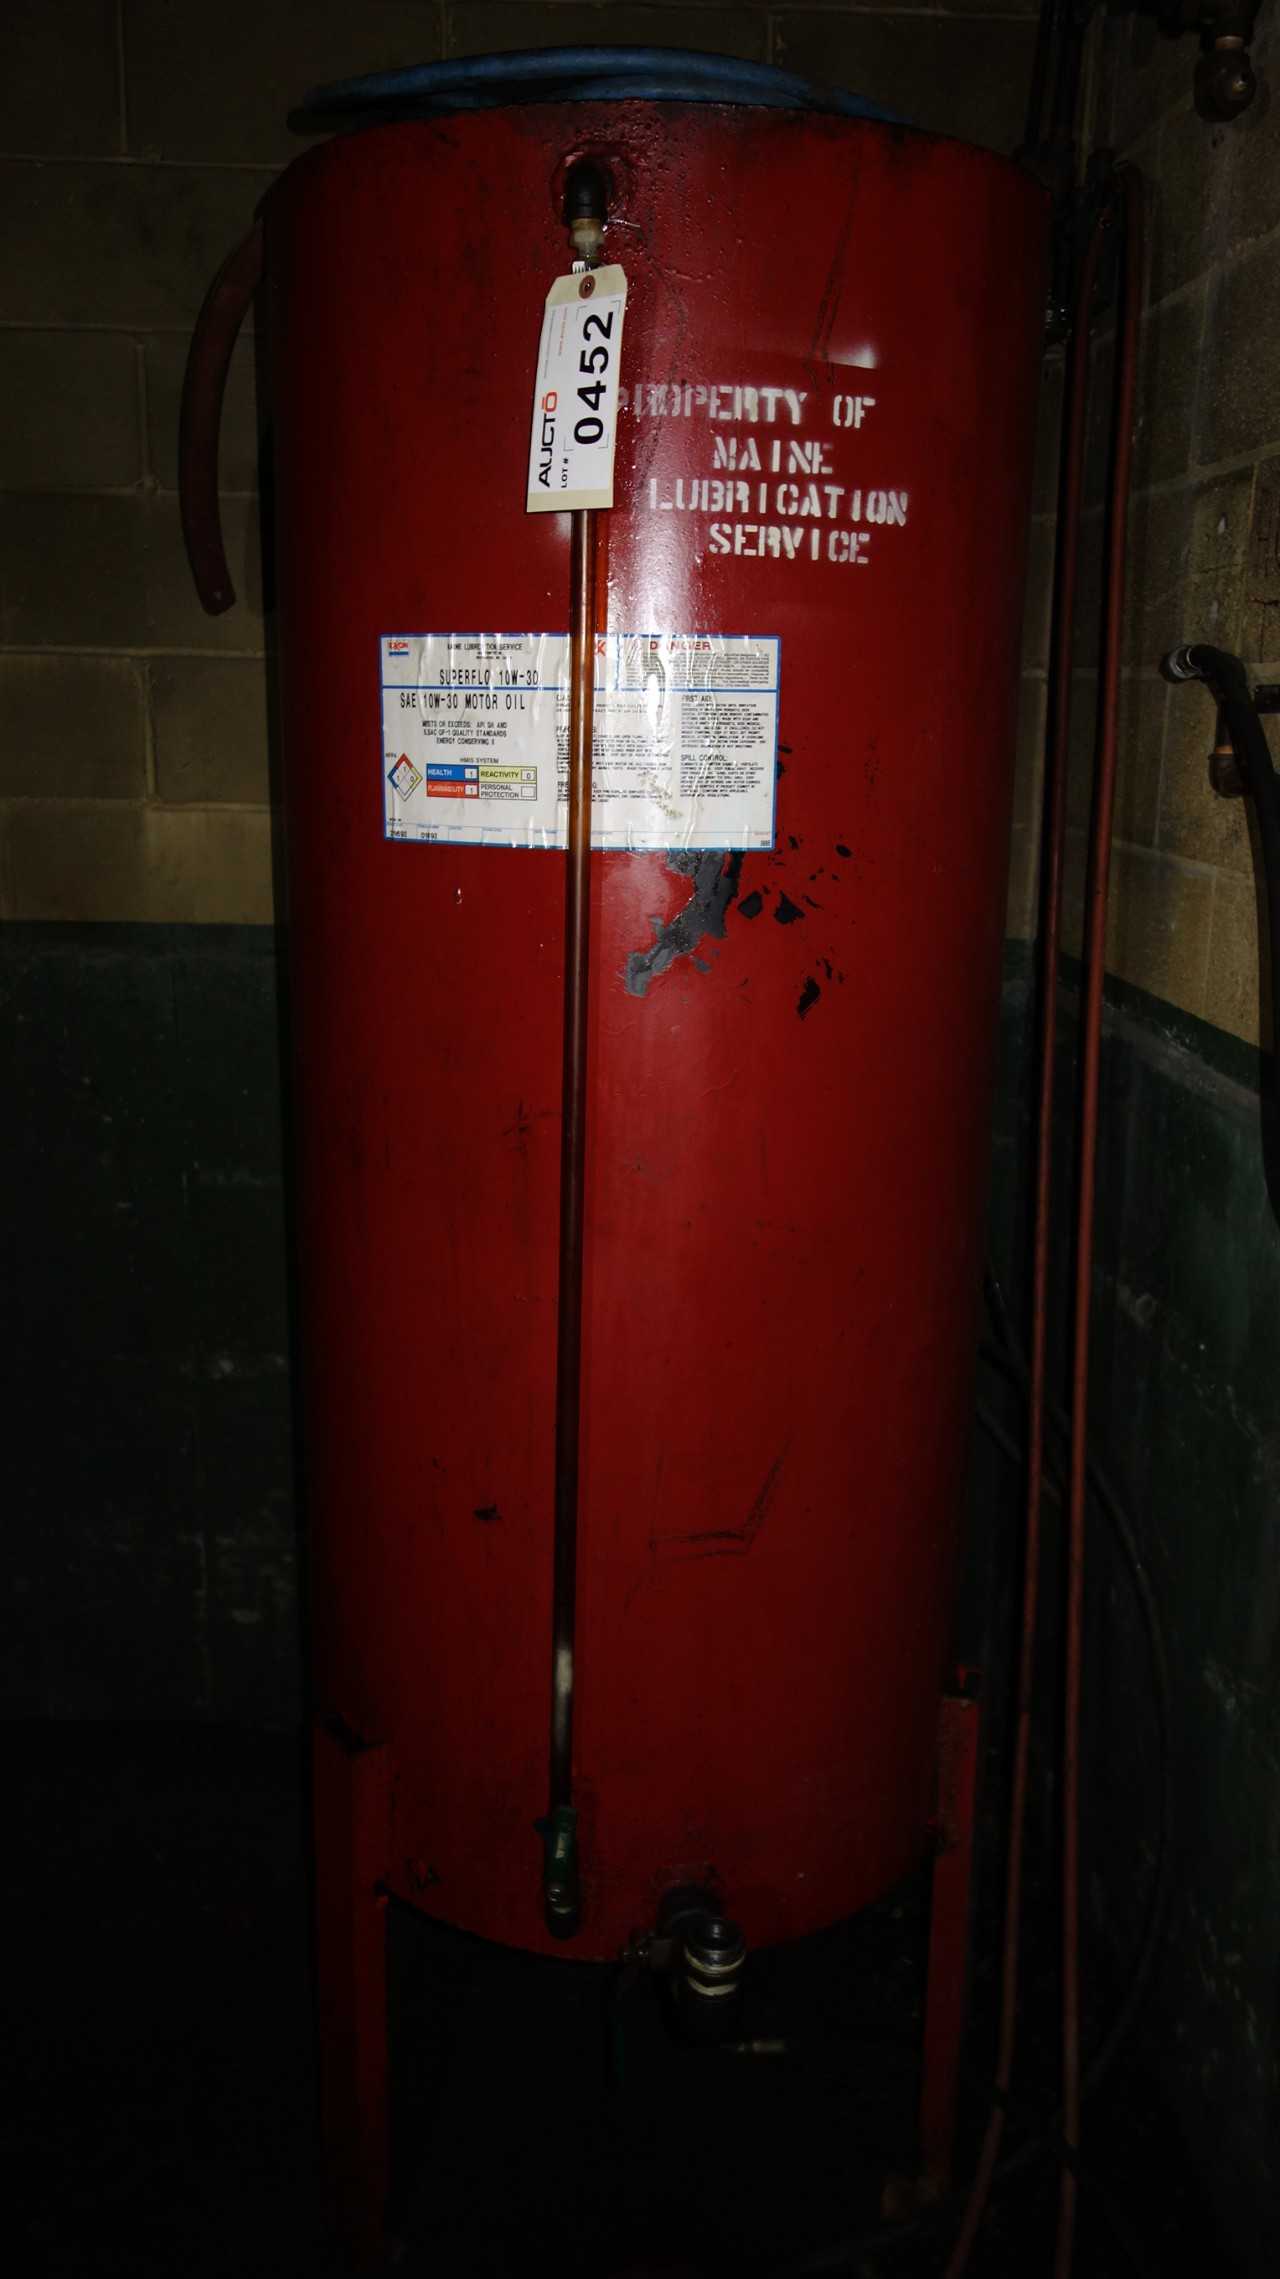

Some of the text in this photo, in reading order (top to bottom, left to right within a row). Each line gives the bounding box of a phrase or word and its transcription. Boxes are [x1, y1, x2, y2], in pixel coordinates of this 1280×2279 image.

[574, 312, 614, 445] 0452
[832, 394, 876, 428] OF
[563, 457, 569, 465] #
[713, 437, 833, 474] MAINE
[650, 478, 909, 527] LUBRICATION
[708, 523, 871, 564] SERVICE
[439, 669, 539, 685] SUPERFLO 10W-30
[400, 693, 525, 710] SAE 10W-30 MOTOR OIL
[436, 737, 455, 745] ENERGY
[452, 729, 474, 737] QUALITY
[427, 768, 452, 776] HEALTH
[480, 770, 519, 778] REACTIVITY
